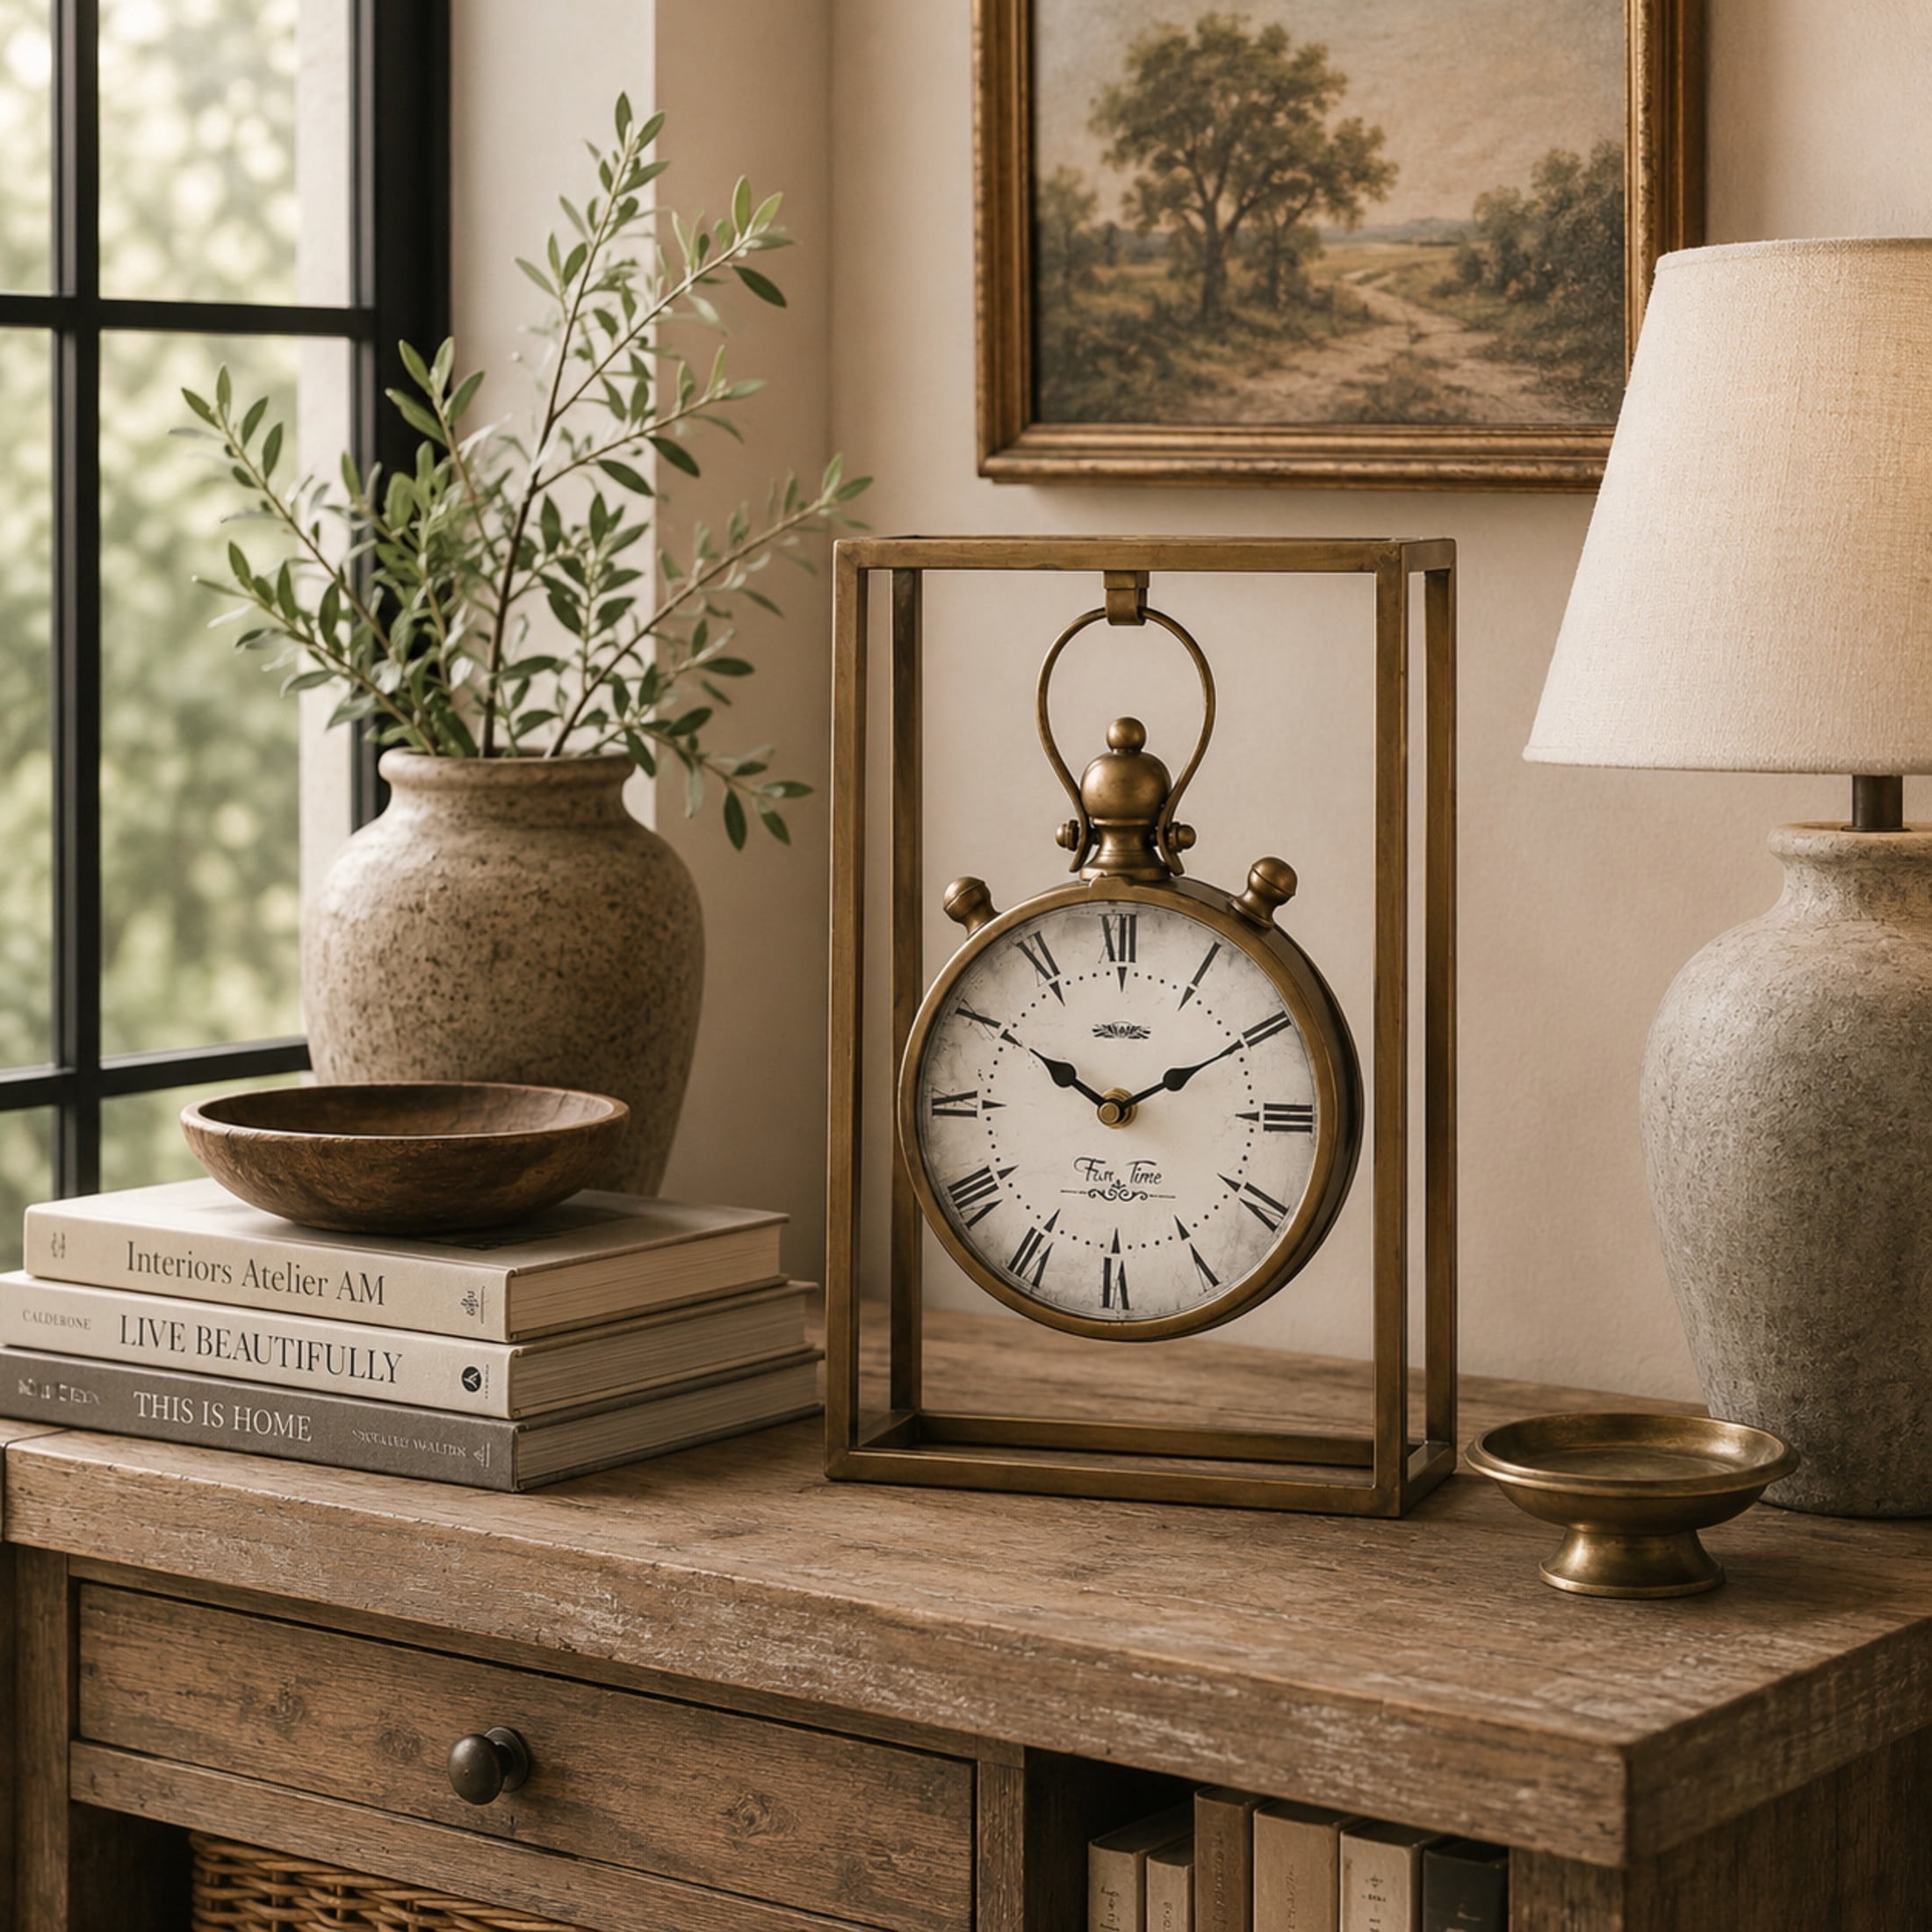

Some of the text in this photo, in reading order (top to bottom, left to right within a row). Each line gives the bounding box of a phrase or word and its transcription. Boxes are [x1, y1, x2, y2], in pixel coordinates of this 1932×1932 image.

[1098, 913, 1136, 963] XII
[1242, 1010, 1292, 1049] II
[1263, 1102, 1314, 1134] III
[1126, 1159, 1163, 1185] Time
[126, 1241, 386, 1307] Interiors Atelier AM
[22, 1309, 92, 1331] CALDERONE
[119, 1314, 403, 1384] LIVE BEAUTIFULLY
[133, 1390, 195, 1425] THIS
[202, 1402, 225, 1429] IS
[234, 1405, 314, 1443] HOME
